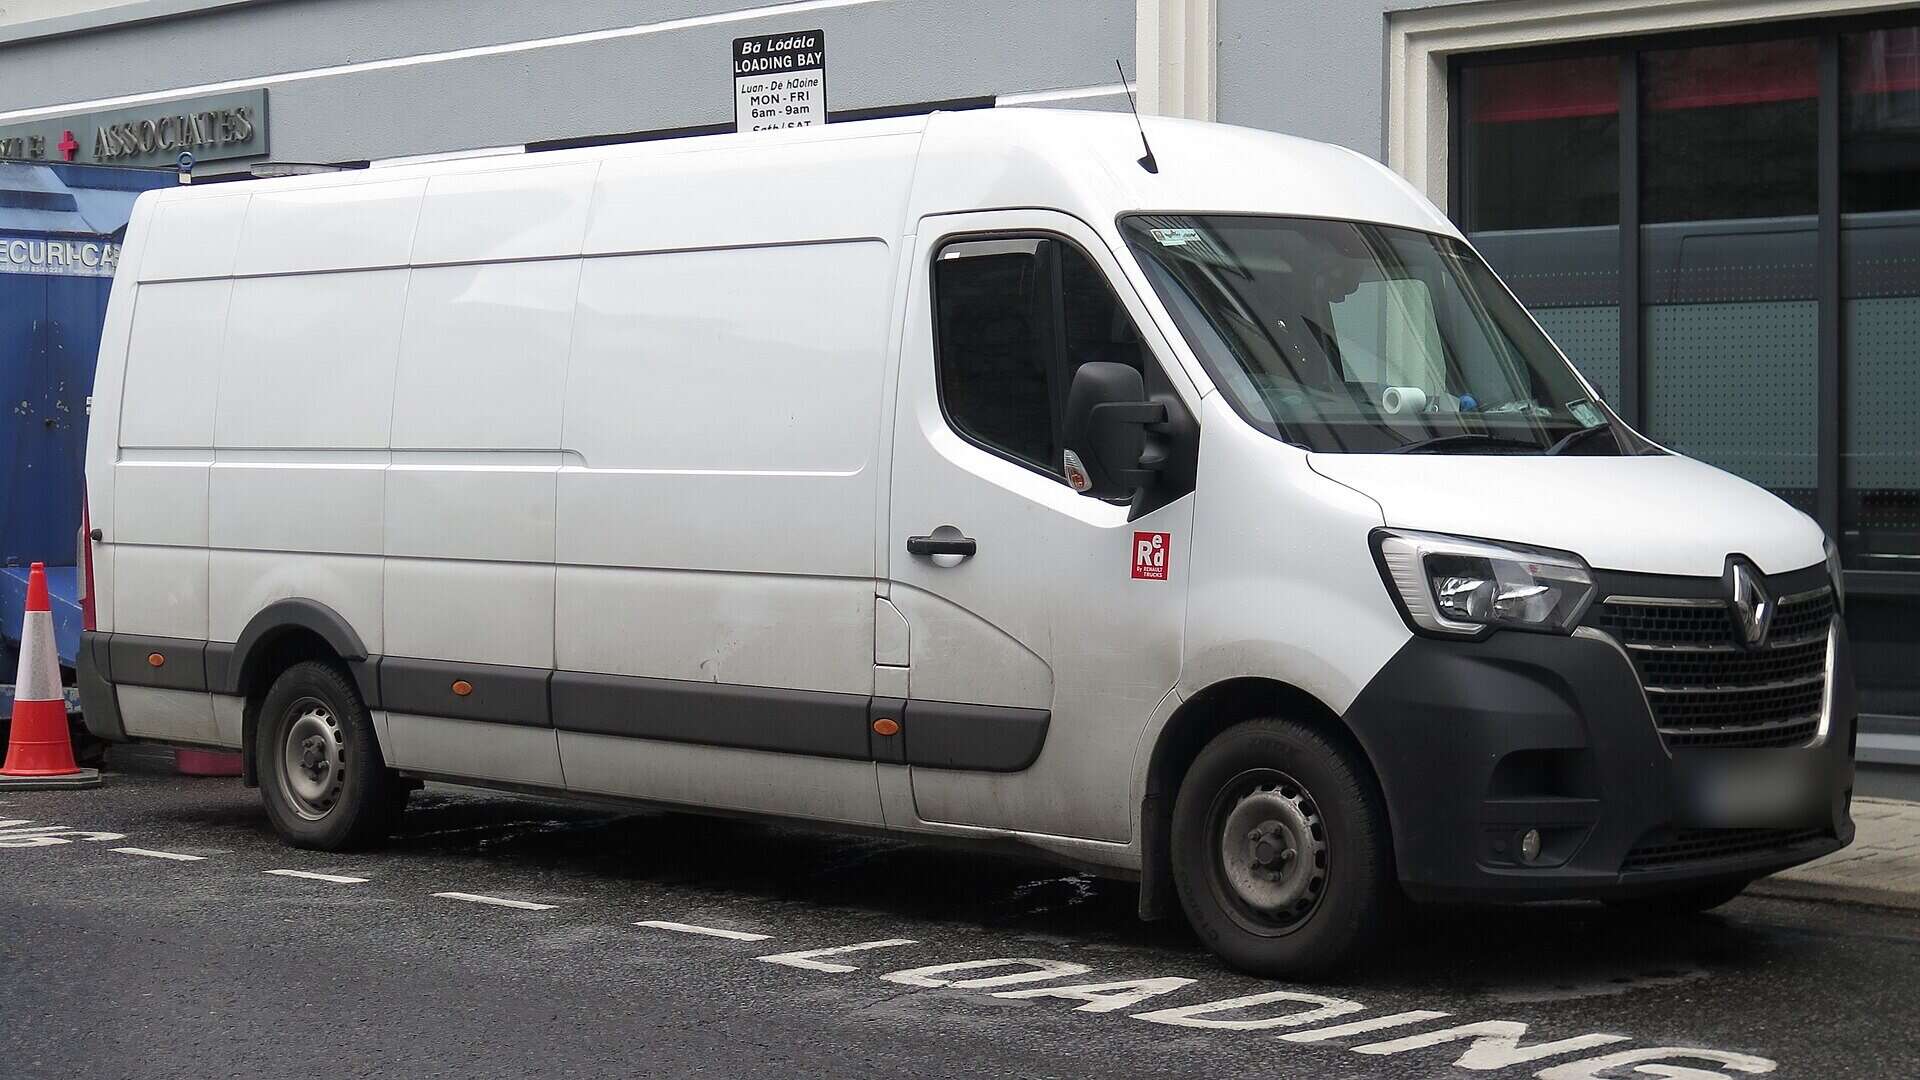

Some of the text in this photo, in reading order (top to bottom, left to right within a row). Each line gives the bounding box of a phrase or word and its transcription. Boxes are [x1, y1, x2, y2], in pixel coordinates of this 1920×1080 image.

[767, 35, 815, 52] Lódála
[735, 51, 822, 73] LOADING BAY
[741, 84, 763, 94] Luan
[750, 94, 780, 106] MON
[790, 91, 810, 102] FRI
[751, 108, 776, 119] 6am
[785, 105, 810, 115] 9am
[93, 106, 255, 158] ASSOCIATES
[755, 939, 1777, 1080] LOADING
